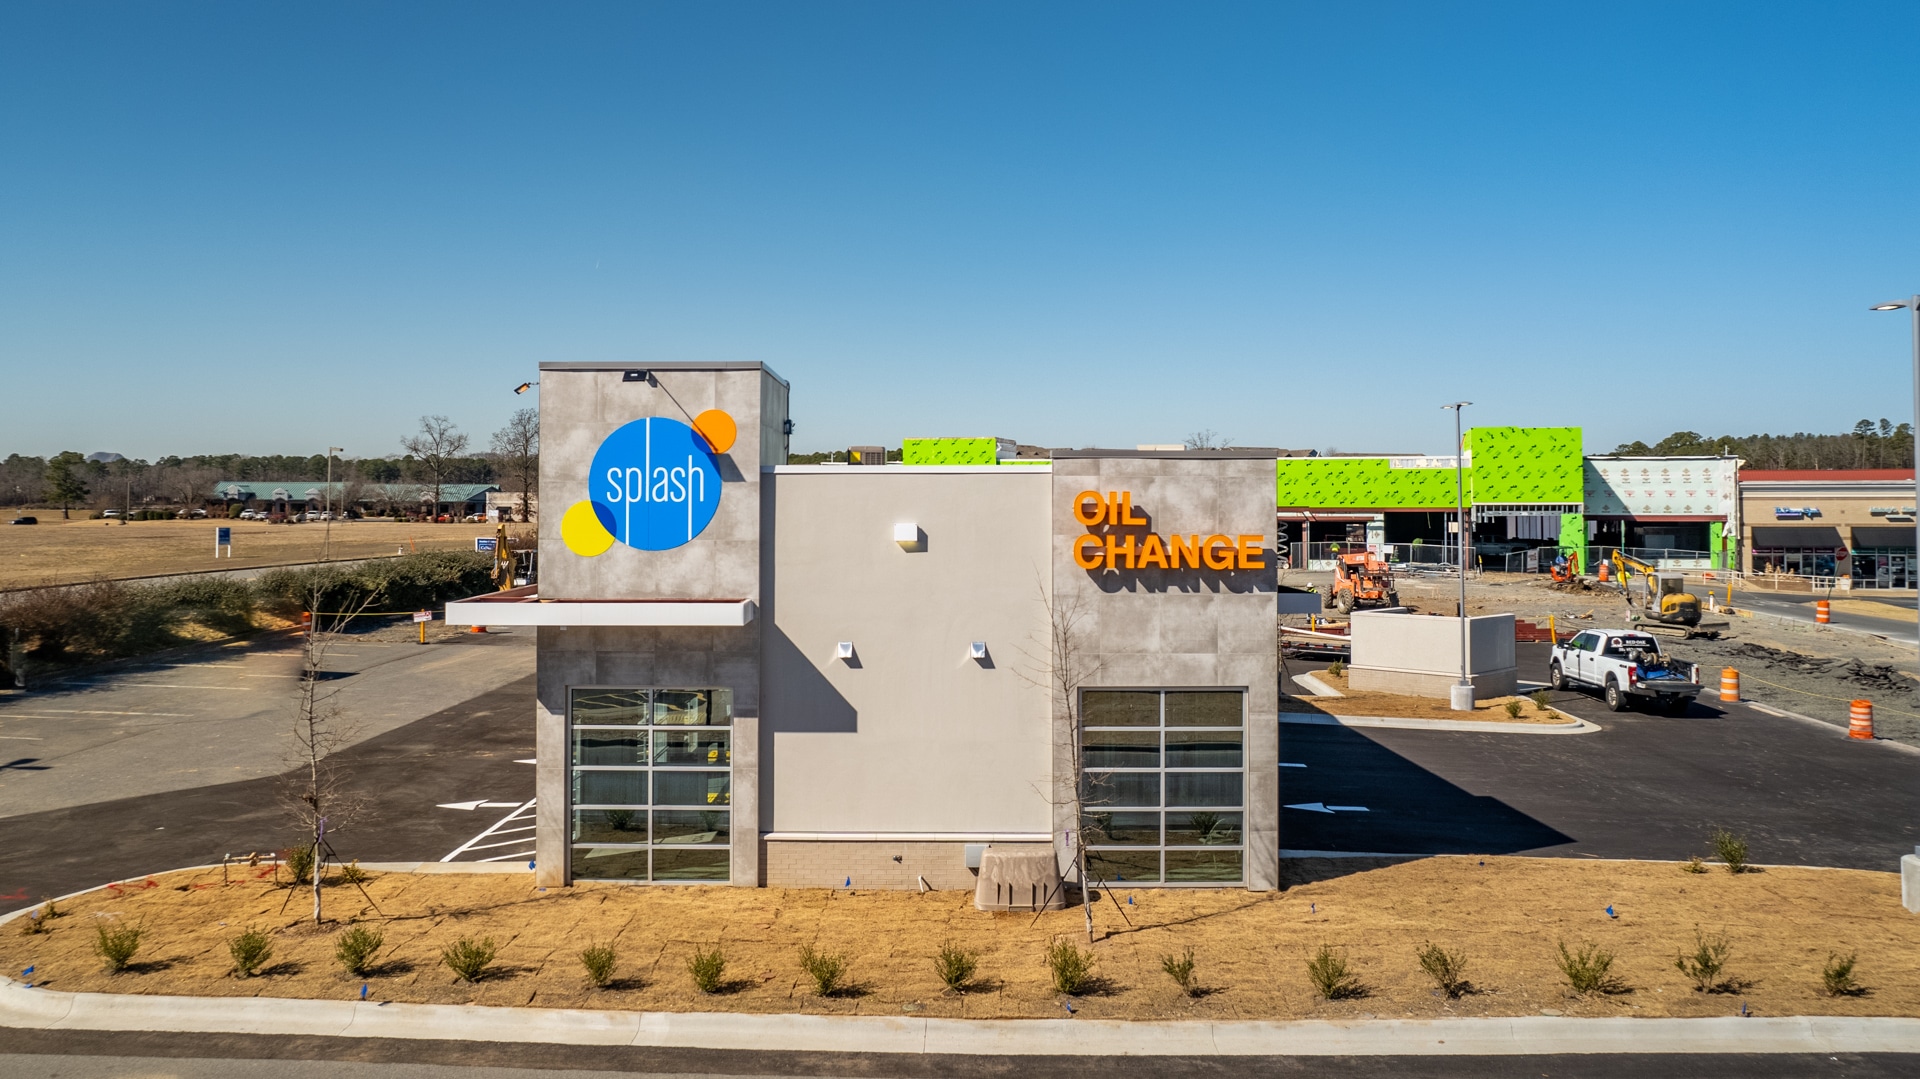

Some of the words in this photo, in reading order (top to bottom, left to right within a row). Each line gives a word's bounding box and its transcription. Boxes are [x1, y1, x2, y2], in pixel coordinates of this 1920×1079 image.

[606, 416, 704, 546] splash
[1073, 490, 1147, 526] OIL
[1073, 533, 1266, 571] CHANGE
